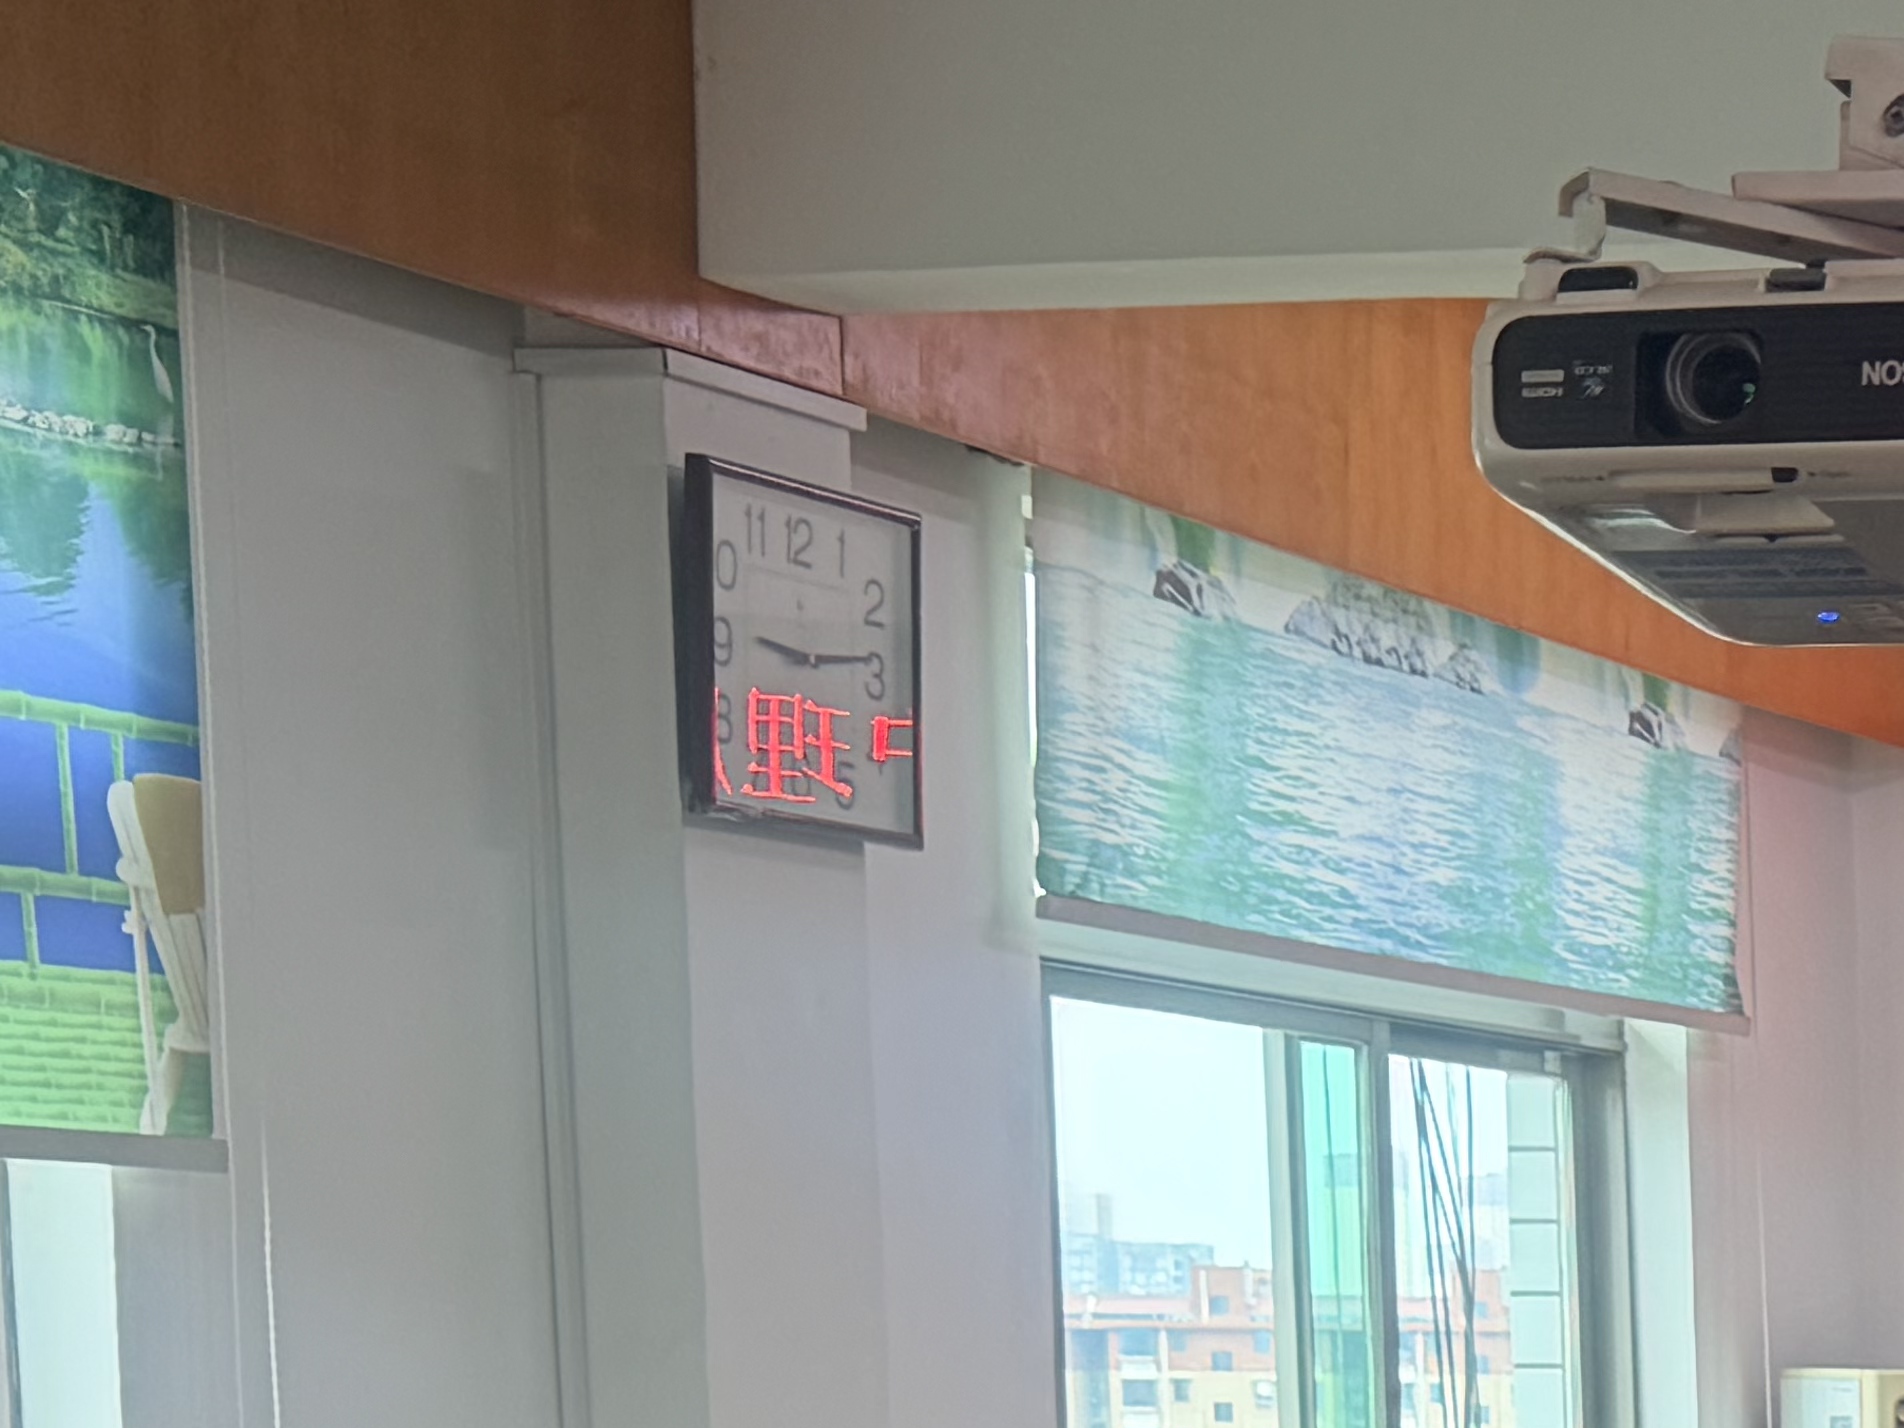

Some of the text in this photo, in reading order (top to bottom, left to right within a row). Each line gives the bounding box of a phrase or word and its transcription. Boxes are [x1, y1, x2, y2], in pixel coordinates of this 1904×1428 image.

[744, 502, 846, 579] 11 12 1
[864, 578, 886, 631] 2
[714, 615, 733, 667] 9
[864, 651, 885, 701] 3
